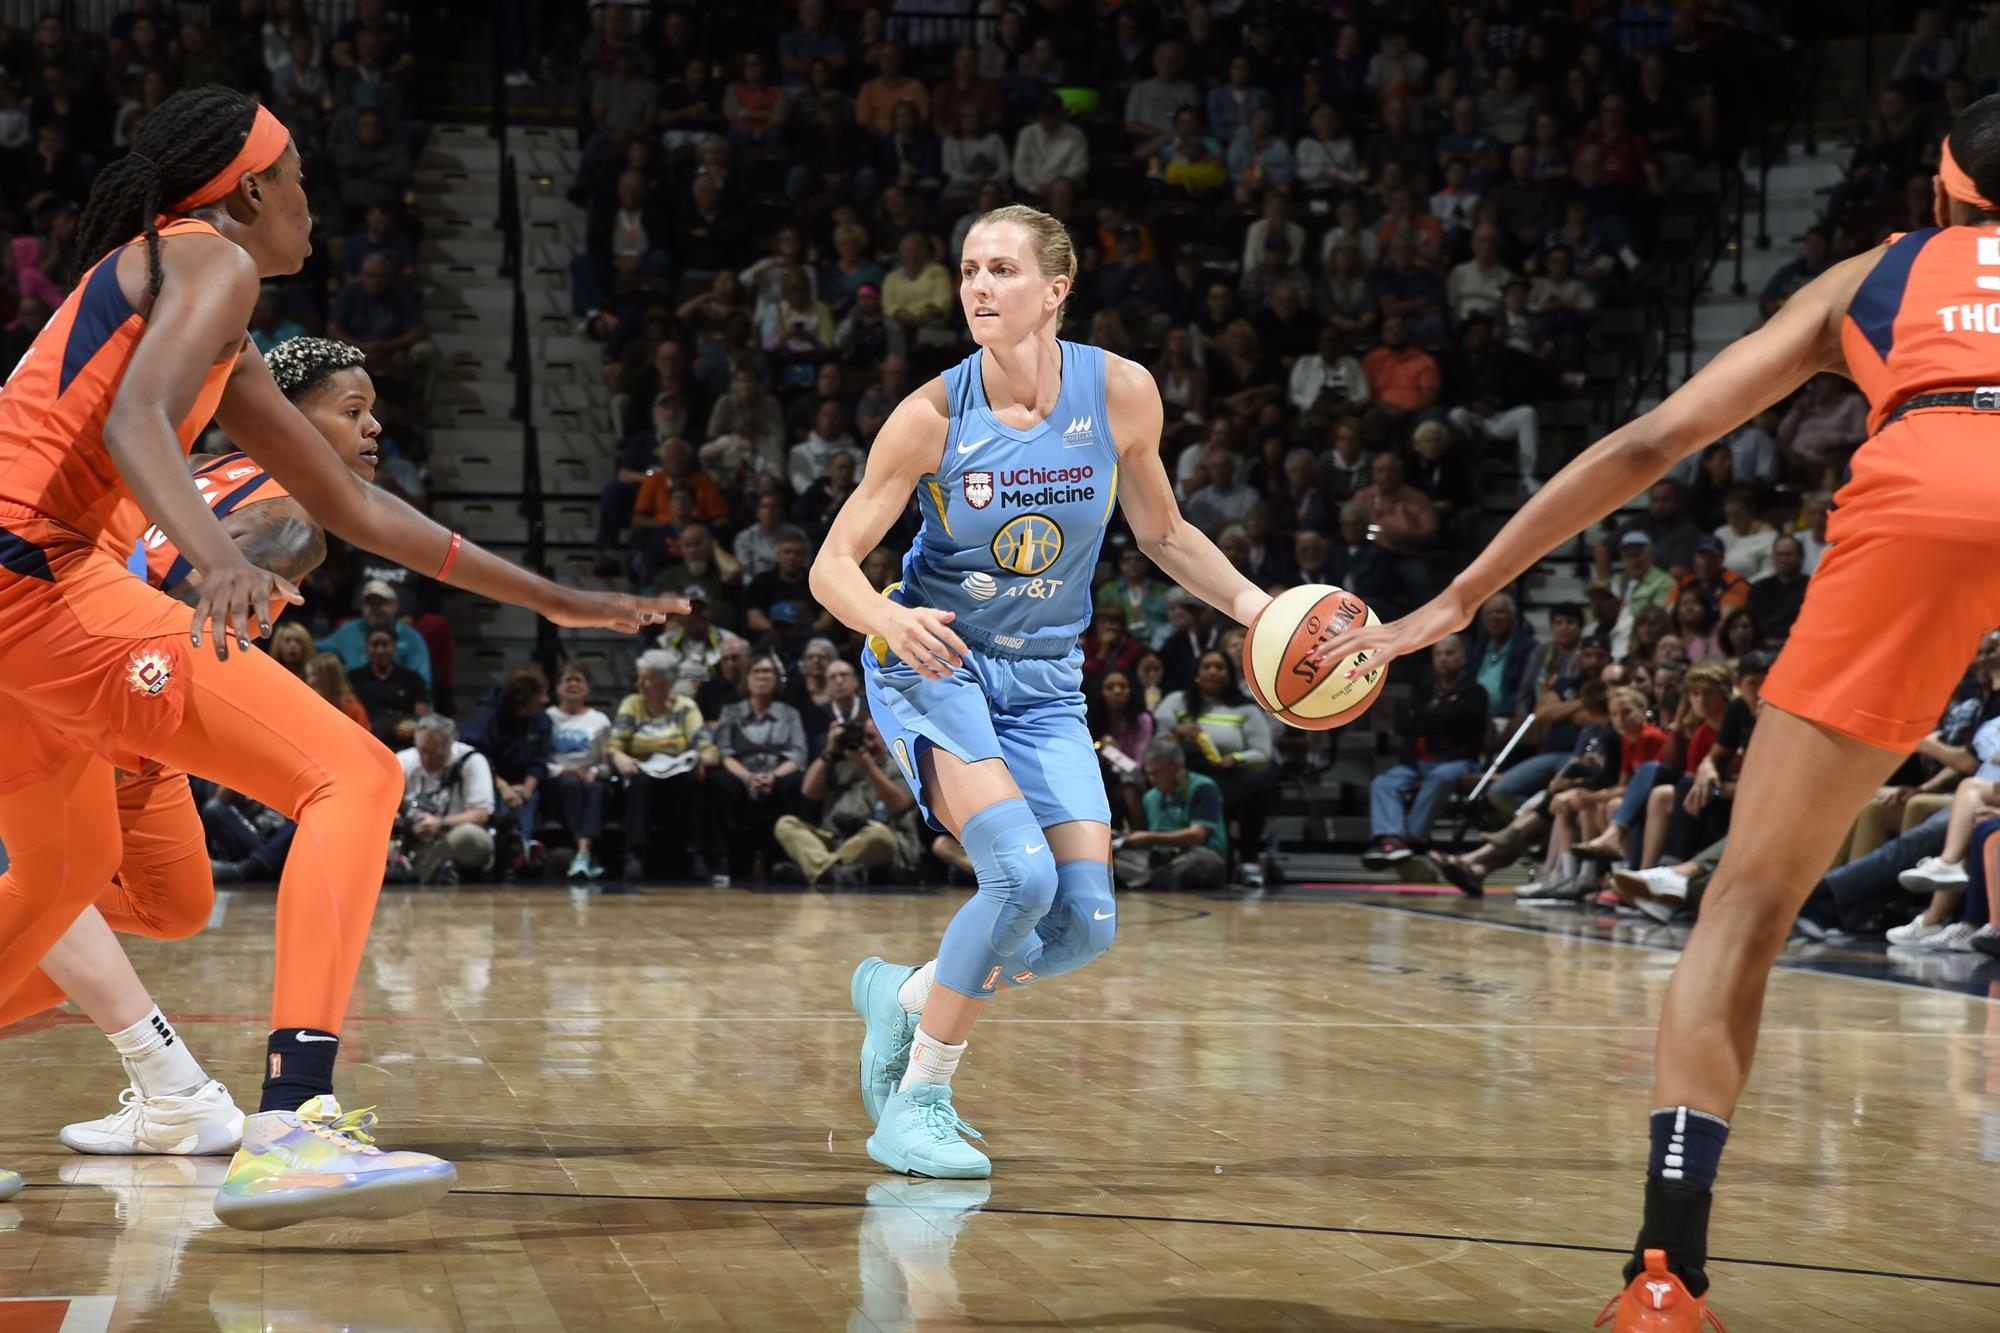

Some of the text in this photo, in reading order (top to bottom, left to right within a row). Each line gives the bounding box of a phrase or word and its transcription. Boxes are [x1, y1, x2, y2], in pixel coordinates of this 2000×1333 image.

[1000, 465, 1094, 487] UChicago
[1001, 485, 1095, 508] Medicine
[1000, 578, 1063, 599] AT&T
[150, 674, 169, 693] SUN
